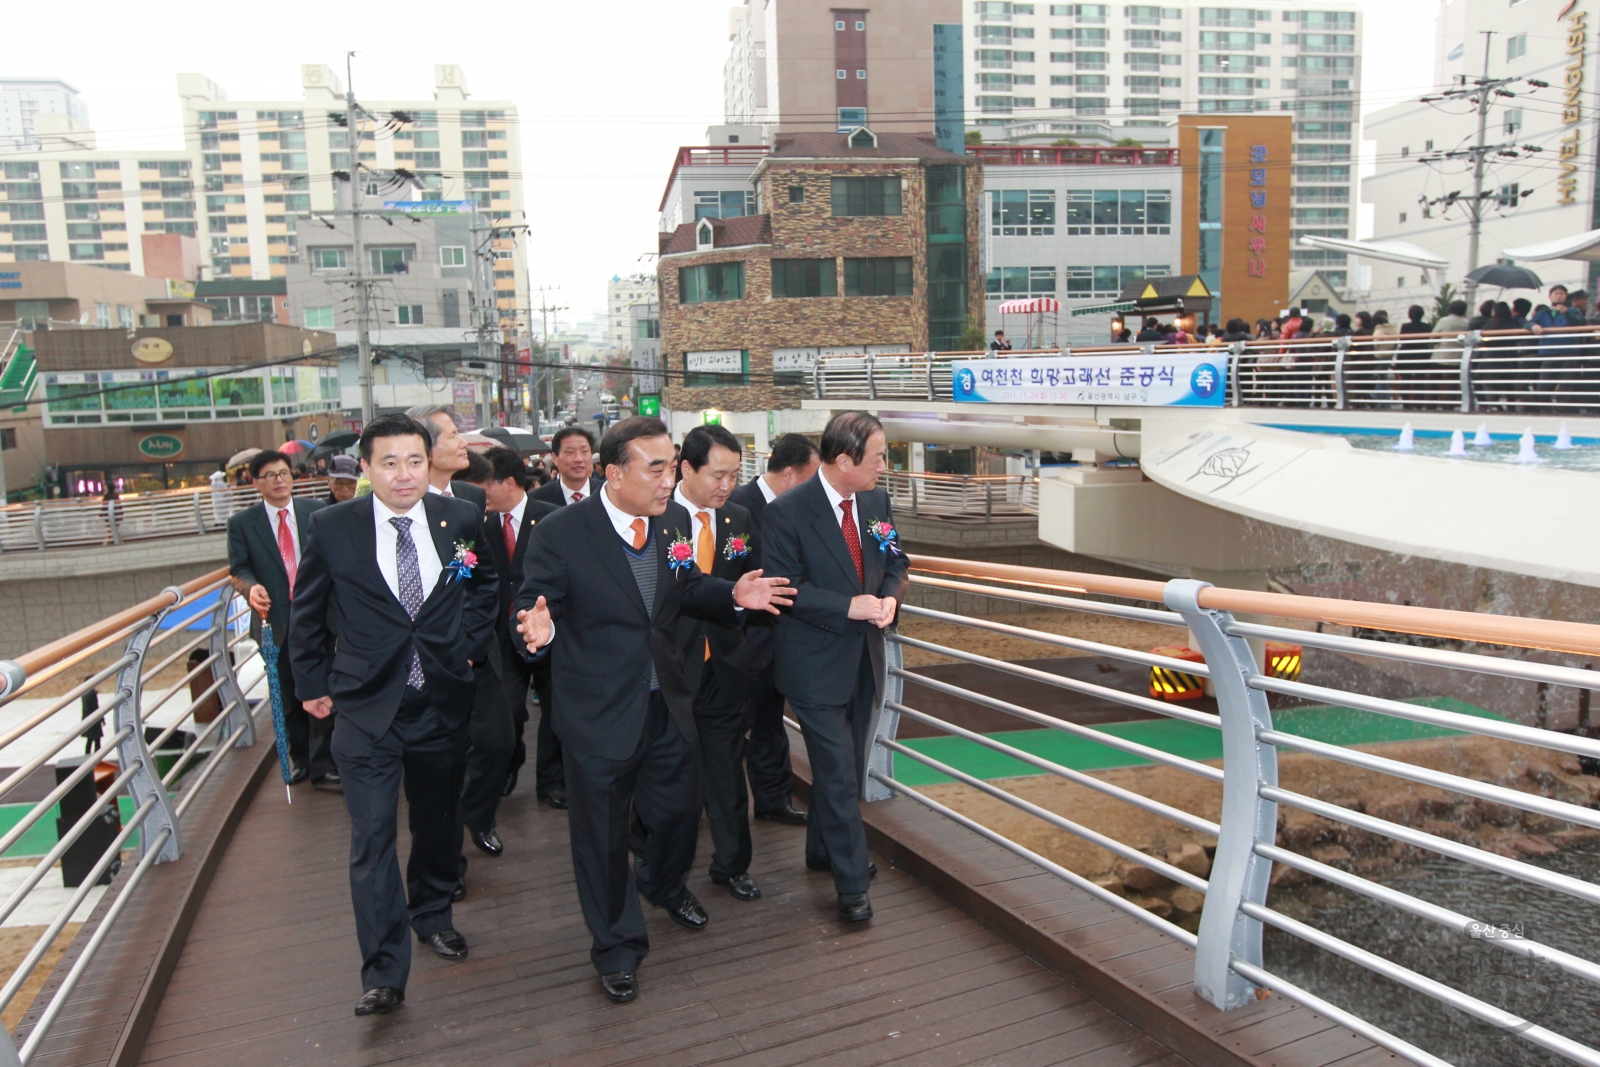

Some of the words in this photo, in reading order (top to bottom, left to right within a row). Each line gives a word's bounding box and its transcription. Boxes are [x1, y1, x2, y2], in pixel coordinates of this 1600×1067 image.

[304, 65, 323, 84] 동
[440, 65, 454, 84] 서
[1561, 11, 1586, 124] ENGLISH
[1250, 145, 1268, 208] 굿모닝
[1557, 129, 1579, 204] HIVEL
[1248, 214, 1267, 277] 사우나
[708, 355, 731, 364] 피아노
[960, 373, 971, 390] 경
[981, 368, 1023, 387] 여천천
[1030, 367, 1111, 387] 희망고래선
[1120, 365, 1175, 387] 준공식
[1195, 369, 1214, 391] 축
[1050, 391, 1068, 399] 13:30
[1088, 391, 1120, 401] 울산광역시
[1124, 391, 1137, 401] 남구
